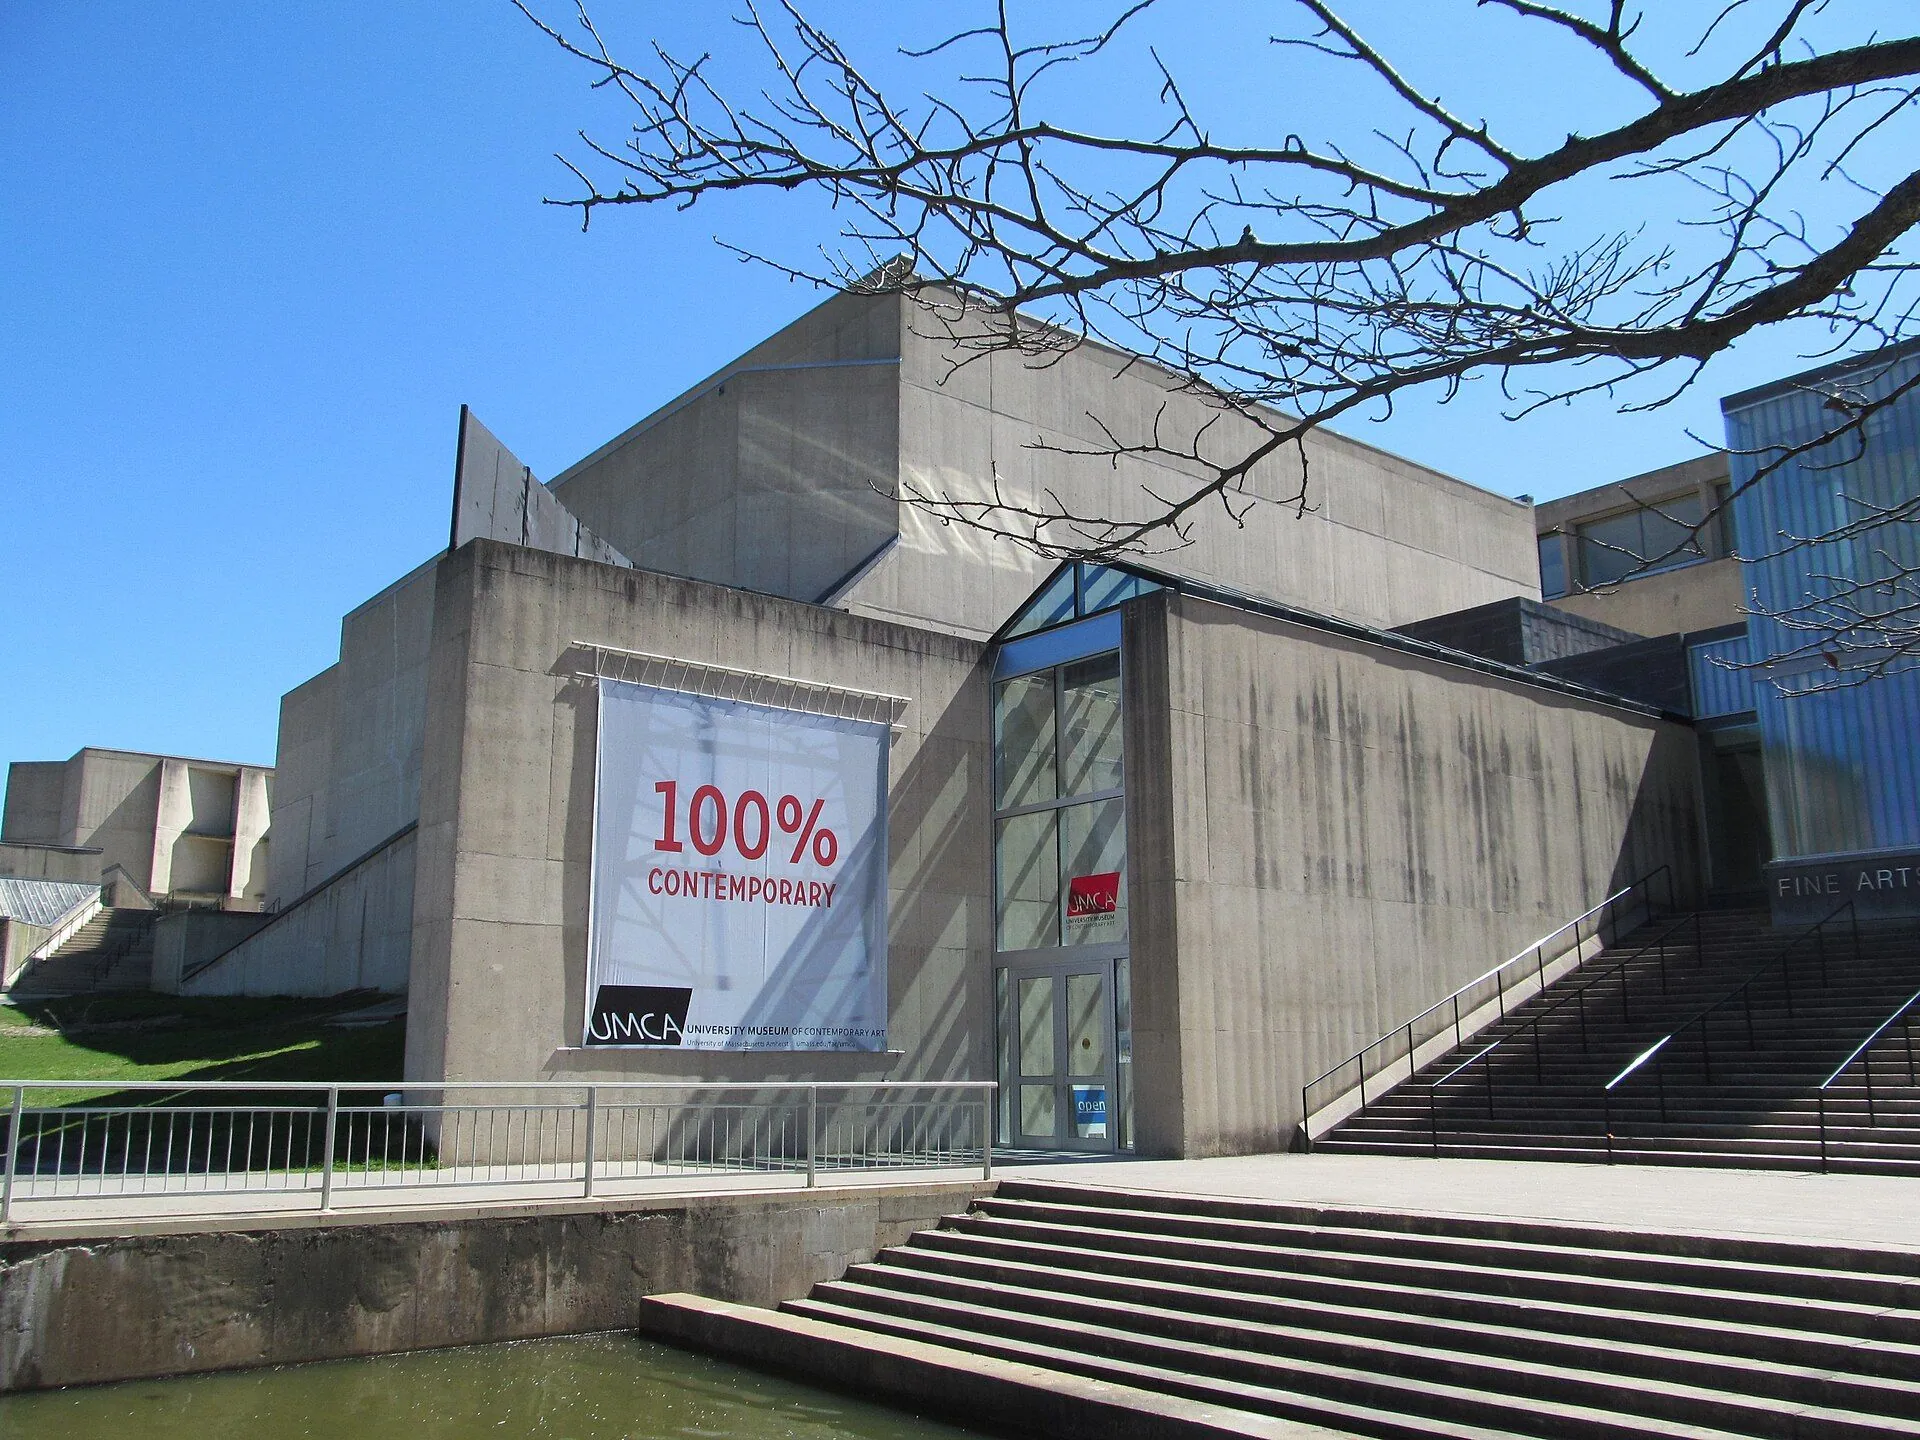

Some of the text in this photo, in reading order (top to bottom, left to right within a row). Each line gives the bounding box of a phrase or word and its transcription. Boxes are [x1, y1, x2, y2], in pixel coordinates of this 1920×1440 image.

[655, 781, 837, 867] 100%
[648, 867, 836, 909] CONTEMPORARY
[1778, 874, 1840, 898] FINE
[590, 1012, 684, 1041] UMCA
[687, 1024, 885, 1038] UNIVERSITY MUSEUM OF CONTEMPORARY ART
[687, 1039, 716, 1048] University
[1078, 1101, 1106, 1111] open
